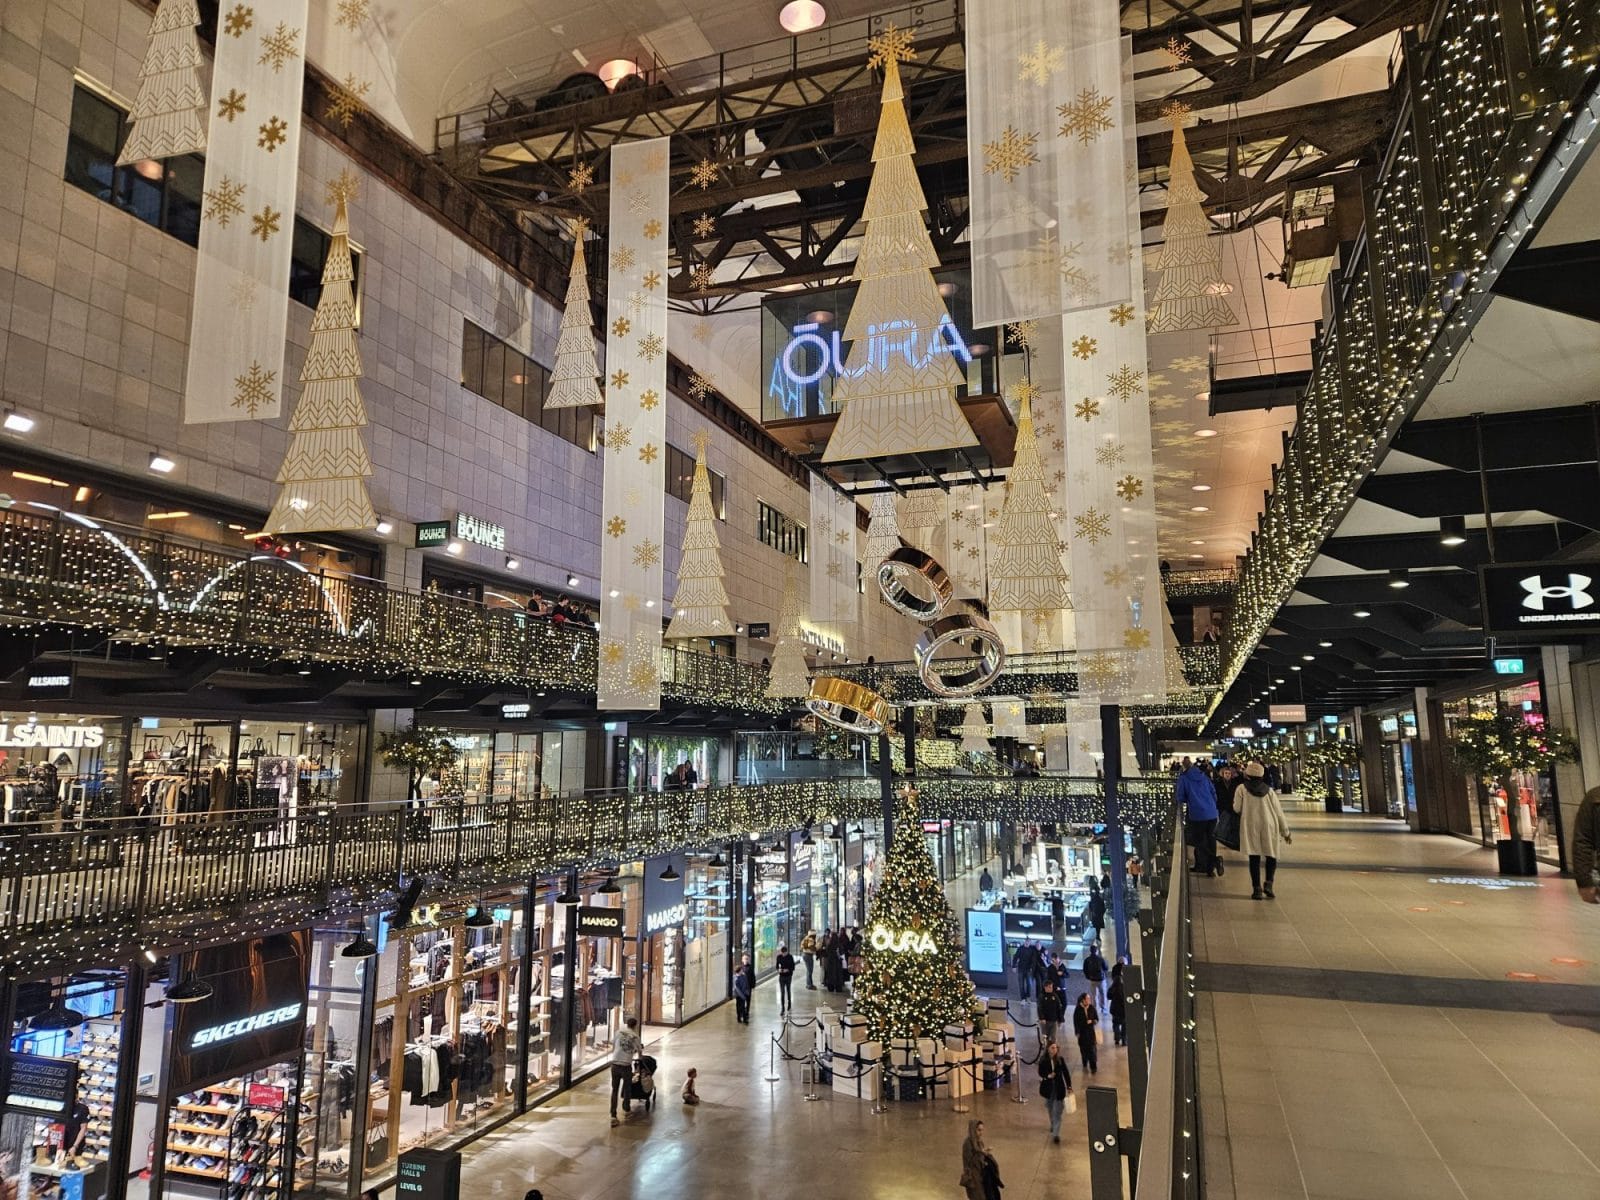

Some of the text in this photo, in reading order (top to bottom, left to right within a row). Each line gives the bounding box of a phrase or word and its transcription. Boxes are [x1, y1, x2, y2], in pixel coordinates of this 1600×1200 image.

[419, 527, 447, 541] BOUNCE
[457, 512, 505, 550] BOUNCE
[28, 676, 70, 687] ALLSAINTS
[0, 724, 104, 748] LSAINTS
[582, 917, 618, 927] MANGO
[647, 903, 687, 933] MANGO
[191, 1002, 302, 1049] SKECHERS
[401, 1162, 426, 1172] TURBINE
[401, 1169, 415, 1177] HALL
[400, 1182, 416, 1191] LEVEL
